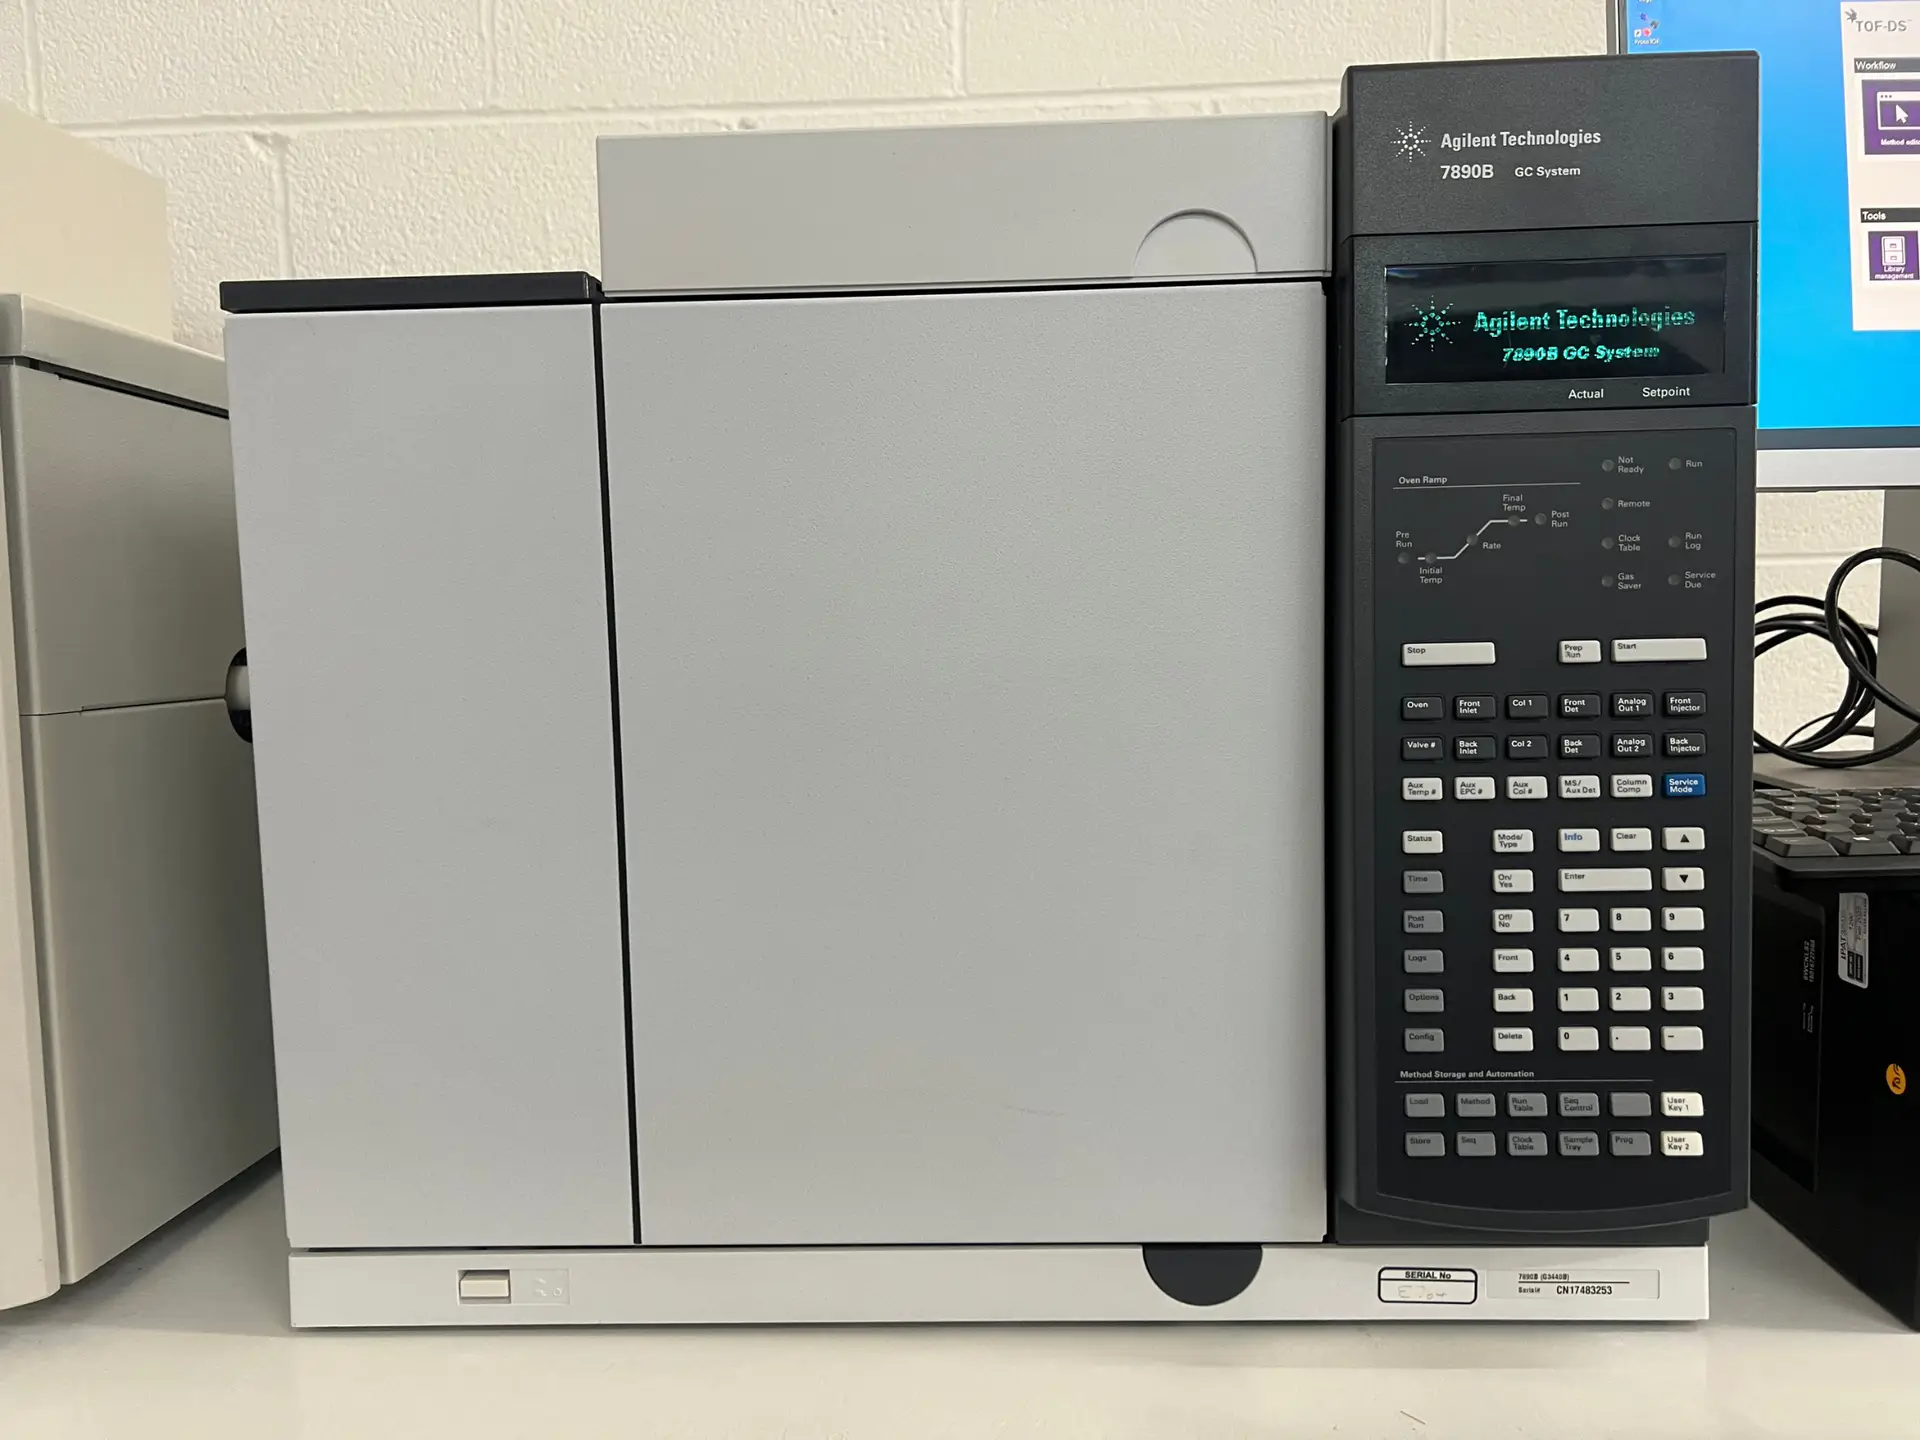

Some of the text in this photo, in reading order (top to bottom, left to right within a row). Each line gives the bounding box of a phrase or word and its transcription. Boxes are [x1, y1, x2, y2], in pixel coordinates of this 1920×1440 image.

[1855, 20, 1907, 32] TOF-DS
[1855, 60, 1897, 70] Workflow
[1440, 130, 1601, 151] Agilent Technologies
[1440, 165, 1581, 179] 7890B GC System
[1862, 210, 1886, 221] Tools
[1874, 272, 1914, 280] management
[1473, 306, 1695, 337] Agilent Technologies
[1503, 345, 1660, 362] 7890B GC System
[1568, 388, 1604, 399] Actual
[1642, 386, 1690, 399] Setpoint
[1618, 466, 1644, 474] Ready
[1423, 476, 1447, 485] Ramp
[1503, 504, 1526, 512] Temp
[1685, 542, 1701, 550] Log
[1420, 577, 1442, 585] Temp
[1407, 647, 1426, 655] Stop
[1564, 644, 1583, 652] Prep
[1618, 698, 1646, 707] Analog
[1670, 704, 1700, 712] Injector
[1617, 739, 1645, 747] Analog
[1408, 789, 1429, 797] Temp
[1617, 786, 1641, 794] Comp
[1564, 833, 1583, 841] Info
[1499, 841, 1517, 849] Type
[1408, 954, 1427, 962] Logs
[1409, 1033, 1435, 1041] Config
[1564, 1032, 1569, 1040] 0
[1434, 1070, 1466, 1079] Storage
[1468, 1070, 1483, 1078] and
[1486, 1070, 1534, 1078] Automation
[1461, 1137, 1476, 1145] Seq
[1564, 1136, 1593, 1144] Sample
[1615, 1137, 1633, 1145] Prog
[1668, 1143, 1682, 1151] Key
[1405, 1271, 1451, 1280] SERIAL No
[1540, 1273, 1569, 1282] (G3440B)
[1556, 1286, 1612, 1296] CN17483253
